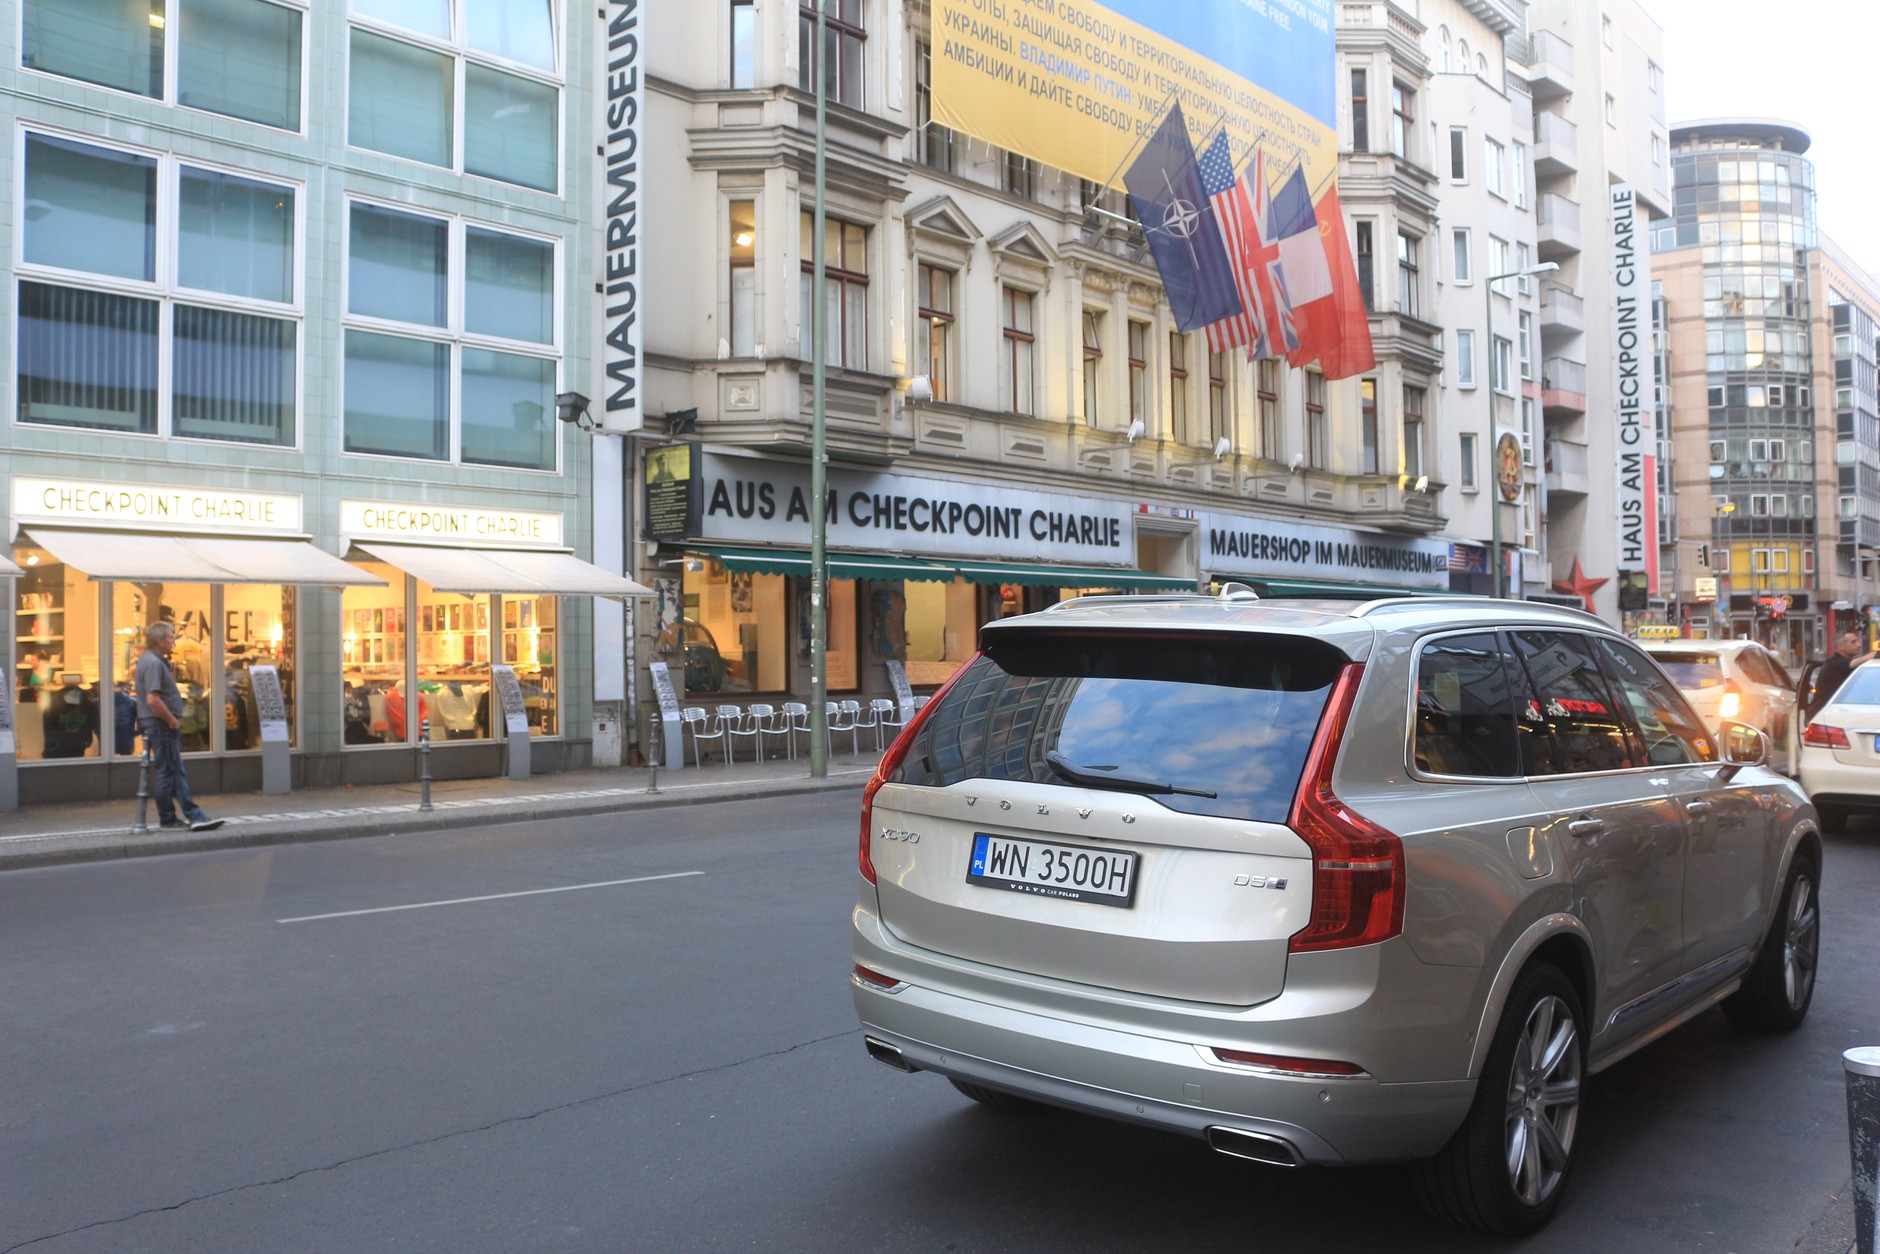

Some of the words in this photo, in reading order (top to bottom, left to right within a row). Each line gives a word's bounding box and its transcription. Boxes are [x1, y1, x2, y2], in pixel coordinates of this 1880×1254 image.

[1307, 8, 1328, 34] YOUR
[944, 6, 1016, 56] УКРАИНЫ.
[1020, 40, 1090, 87] ВЛАДИМИР
[1013, 8, 1082, 56] ЗАЩИЩАЯ
[1085, 42, 1140, 83] СВОБОДУ
[1143, 69, 1151, 88] И
[944, 39, 1014, 84] АМБИЦИИ
[1018, 69, 1027, 90] И
[1030, 75, 1073, 109] ДАЙТЕ
[1076, 94, 1132, 134] СВОБОДУ
[1058, 2, 1116, 45] СВОБОДУ
[1118, 31, 1128, 49] И
[1131, 36, 1233, 100] ТЕРРИТОРИАЛЬНУЮ
[1234, 86, 1296, 134] ЦЕЛОСТНОСТЬ
[1297, 122, 1321, 148] СТРАН
[1613, 189, 1635, 287] CHARLIE
[1617, 296, 1641, 445] CHECKPOINT
[1622, 451, 1641, 491] AM
[43, 487, 181, 516] CHECKPOINT
[191, 497, 274, 522] CHARLIE
[363, 508, 469, 533] CHECKPOINT
[476, 515, 541, 537] CHARLIE
[702, 478, 776, 520] AUS
[849, 491, 1022, 539] CHECKPOINT
[1029, 509, 1120, 547] CHARLIE
[1210, 528, 1311, 564] MAUERSHOP
[1315, 540, 1333, 566] IM
[1337, 543, 1432, 574] MAUERMUSEUM
[1623, 499, 1643, 562] HAUS
[965, 795, 1136, 824] VOLVO
[880, 827, 921, 844] XC90
[974, 860, 984, 870] PL
[990, 842, 1030, 878] WN
[1038, 848, 1129, 892] 3500H
[1010, 883, 1046, 894] VOLVO
[1058, 891, 1080, 899] POLAND
[1233, 873, 1267, 888] D5
